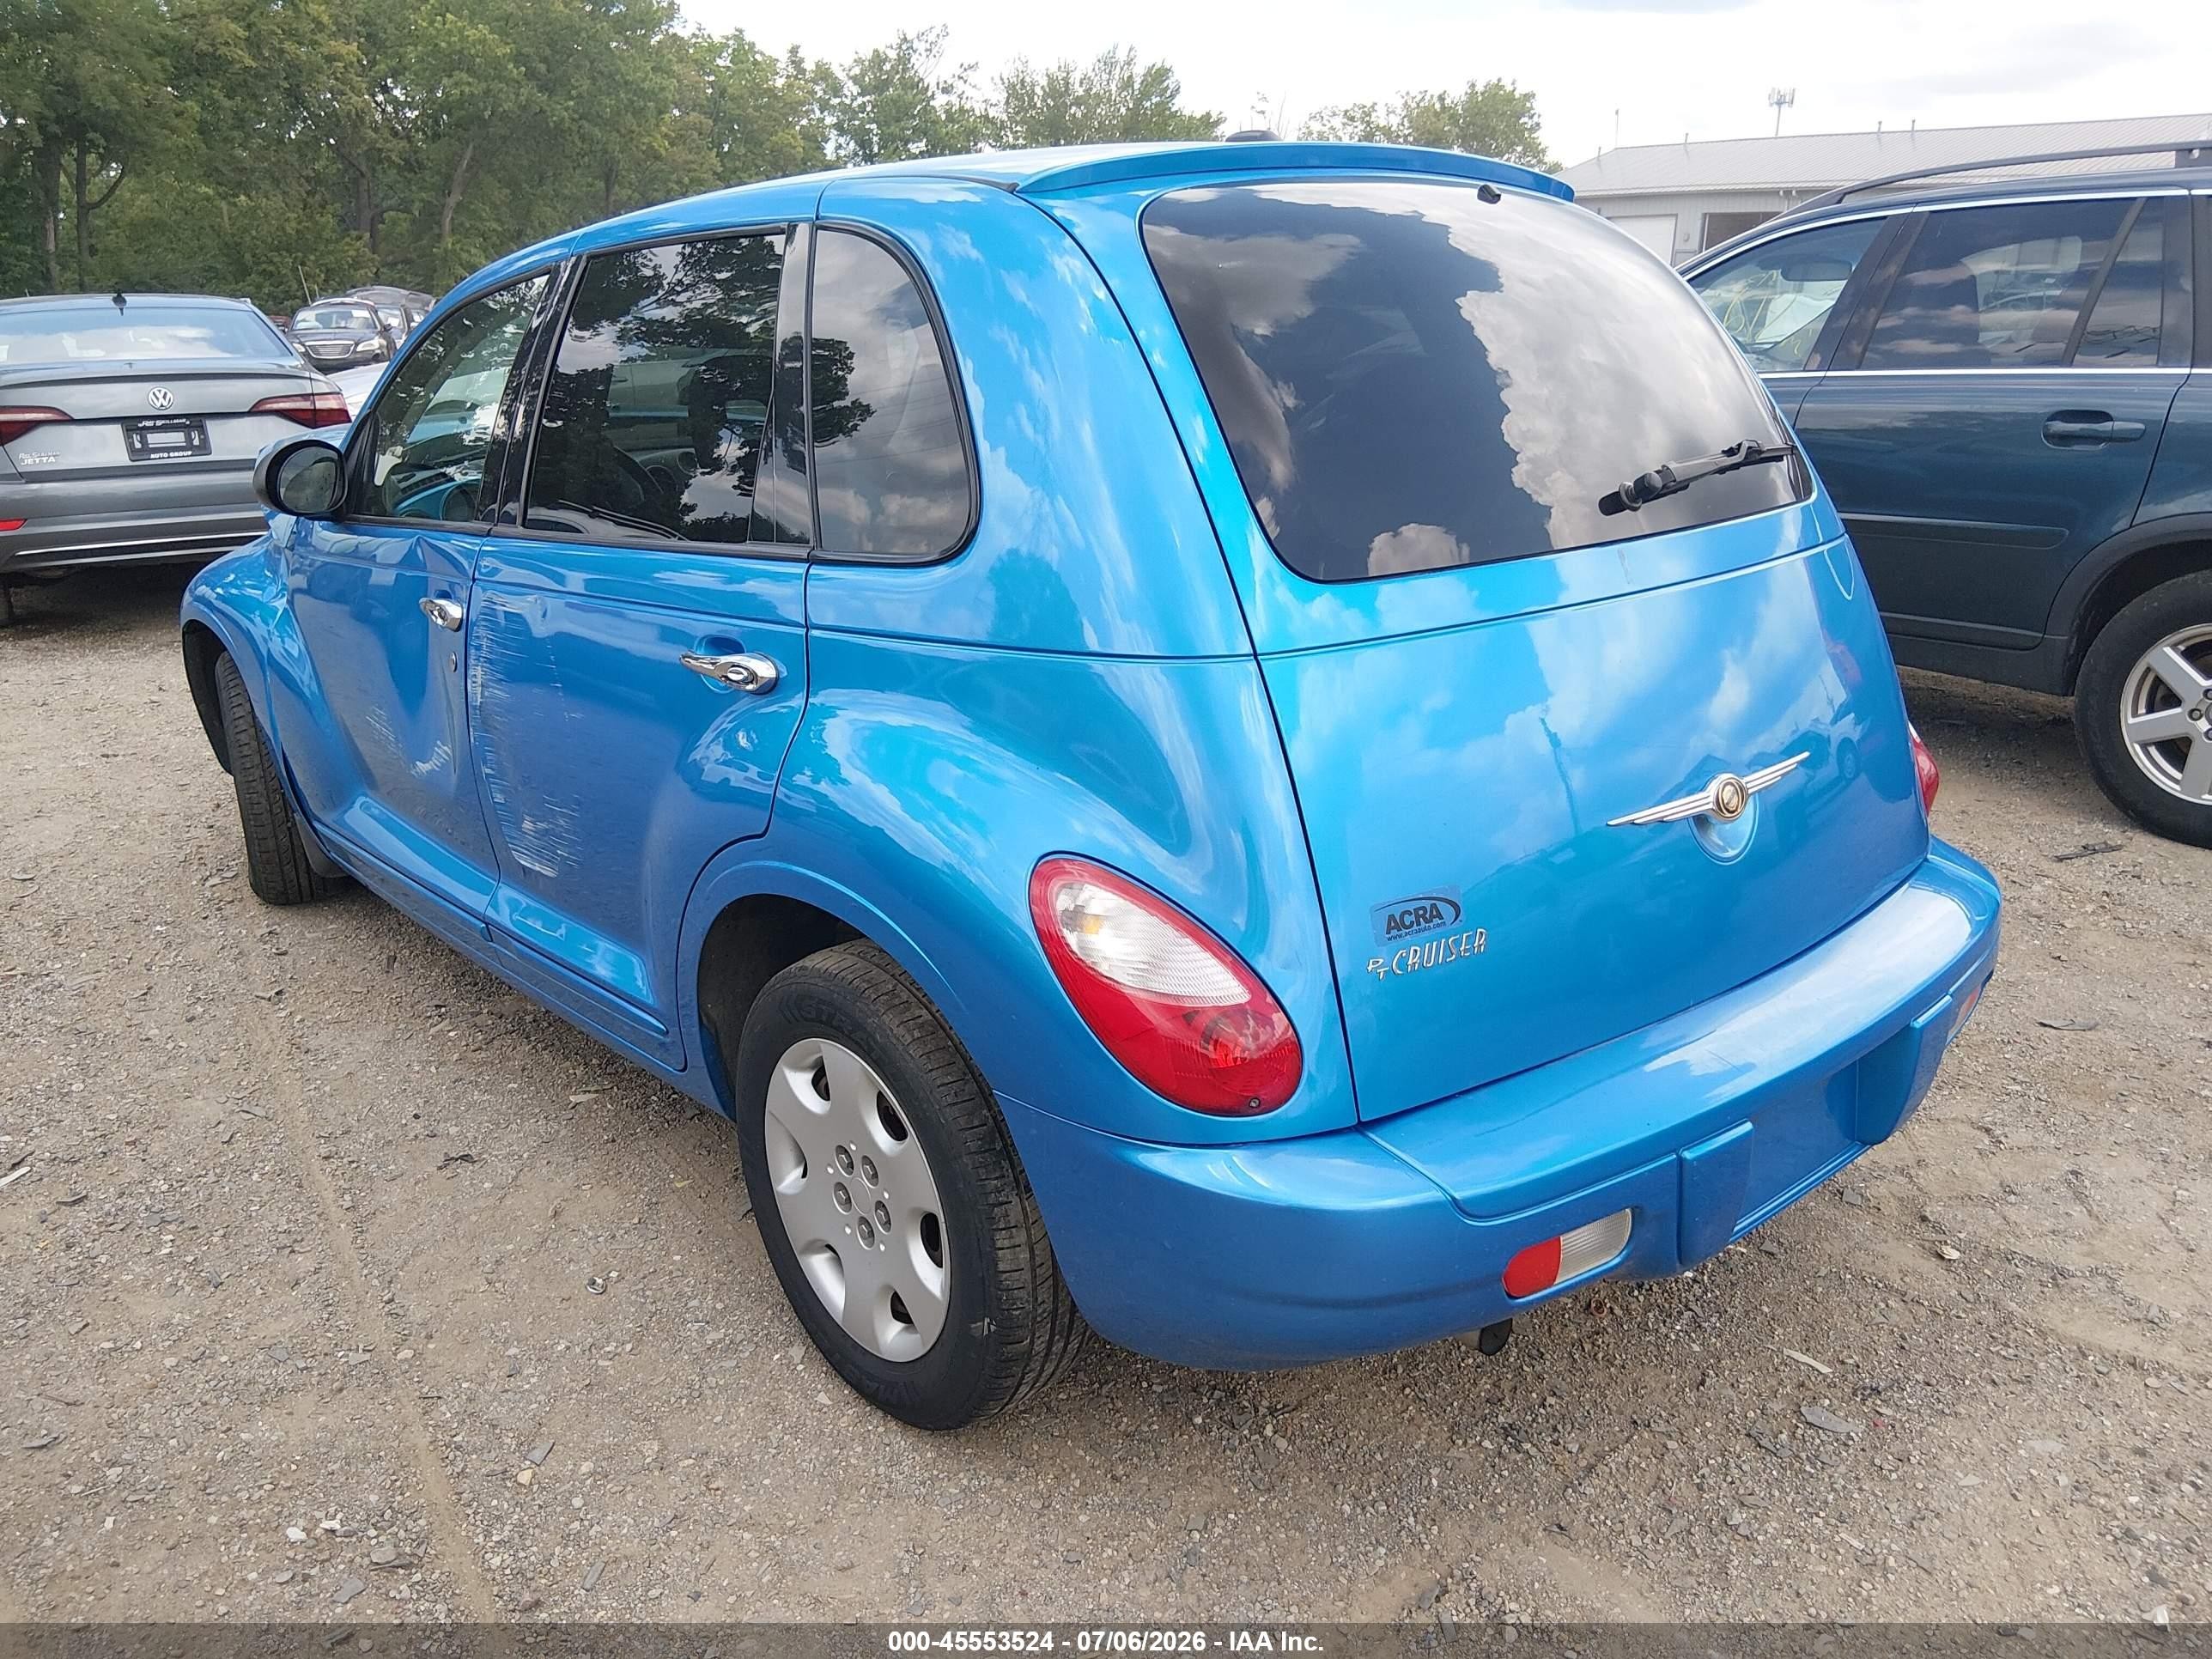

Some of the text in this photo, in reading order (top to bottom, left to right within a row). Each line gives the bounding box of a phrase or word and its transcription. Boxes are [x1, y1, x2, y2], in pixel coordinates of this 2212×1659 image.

[21, 456, 56, 465] JETTA
[1385, 902, 1444, 935] ACRA
[1366, 928, 1488, 981] PT CRUISER
